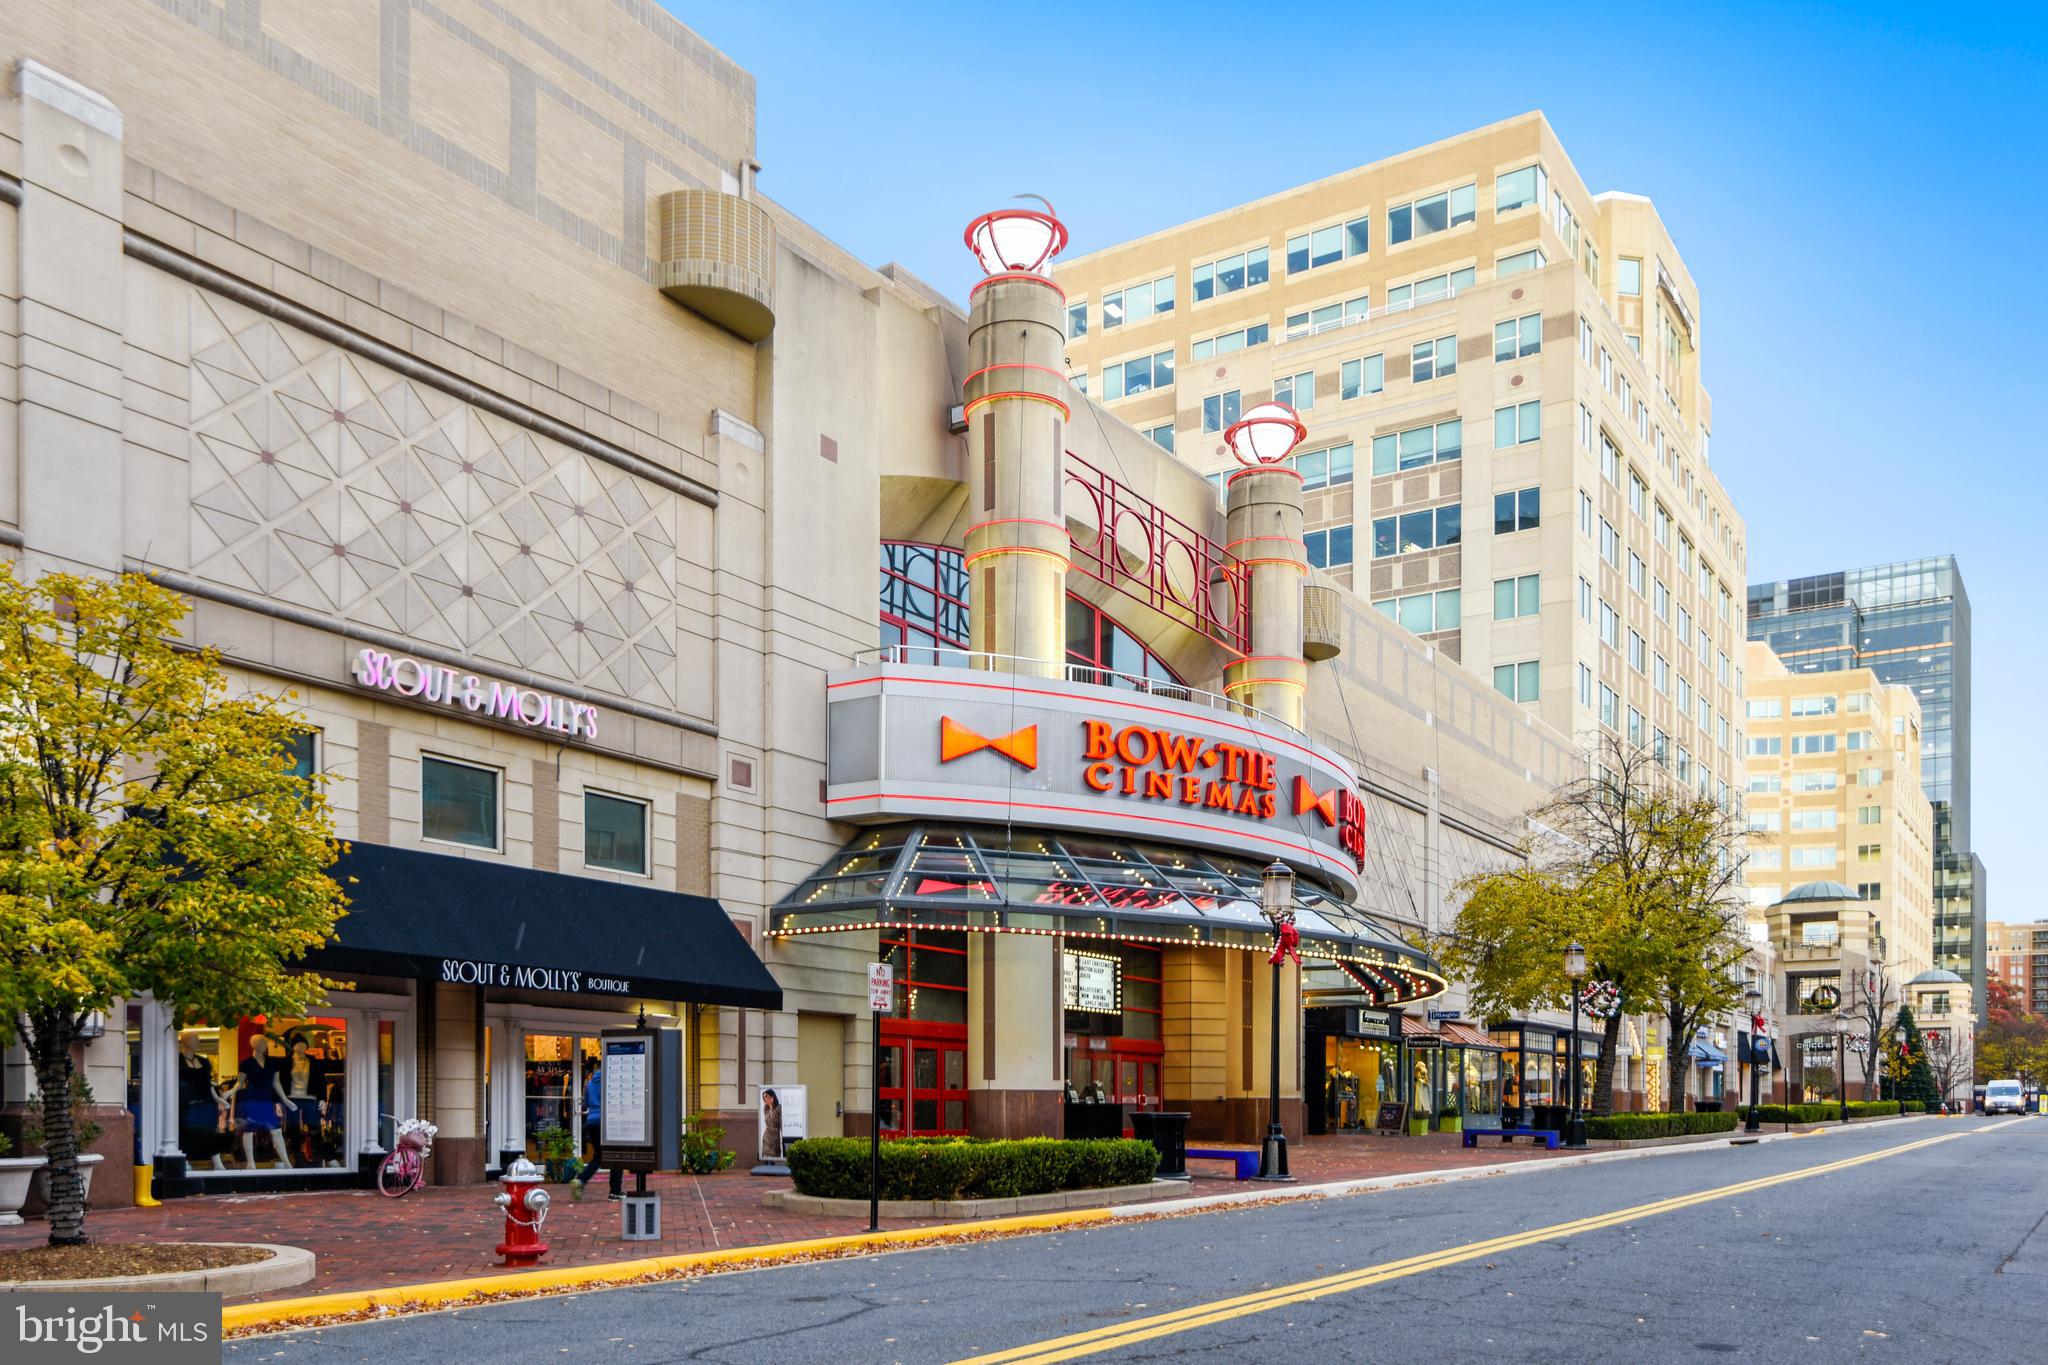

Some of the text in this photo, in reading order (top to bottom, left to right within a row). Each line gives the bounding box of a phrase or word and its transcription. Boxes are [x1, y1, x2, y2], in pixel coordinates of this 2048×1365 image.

[357, 648, 598, 739] SCOUT & MOLLY'S
[1084, 762, 1276, 819] CINEMAS
[443, 959, 630, 993] SCOUT & MOLLY'S BOUTIQUE
[871, 978, 890, 988] PARKING
[876, 968, 885, 977] NO
